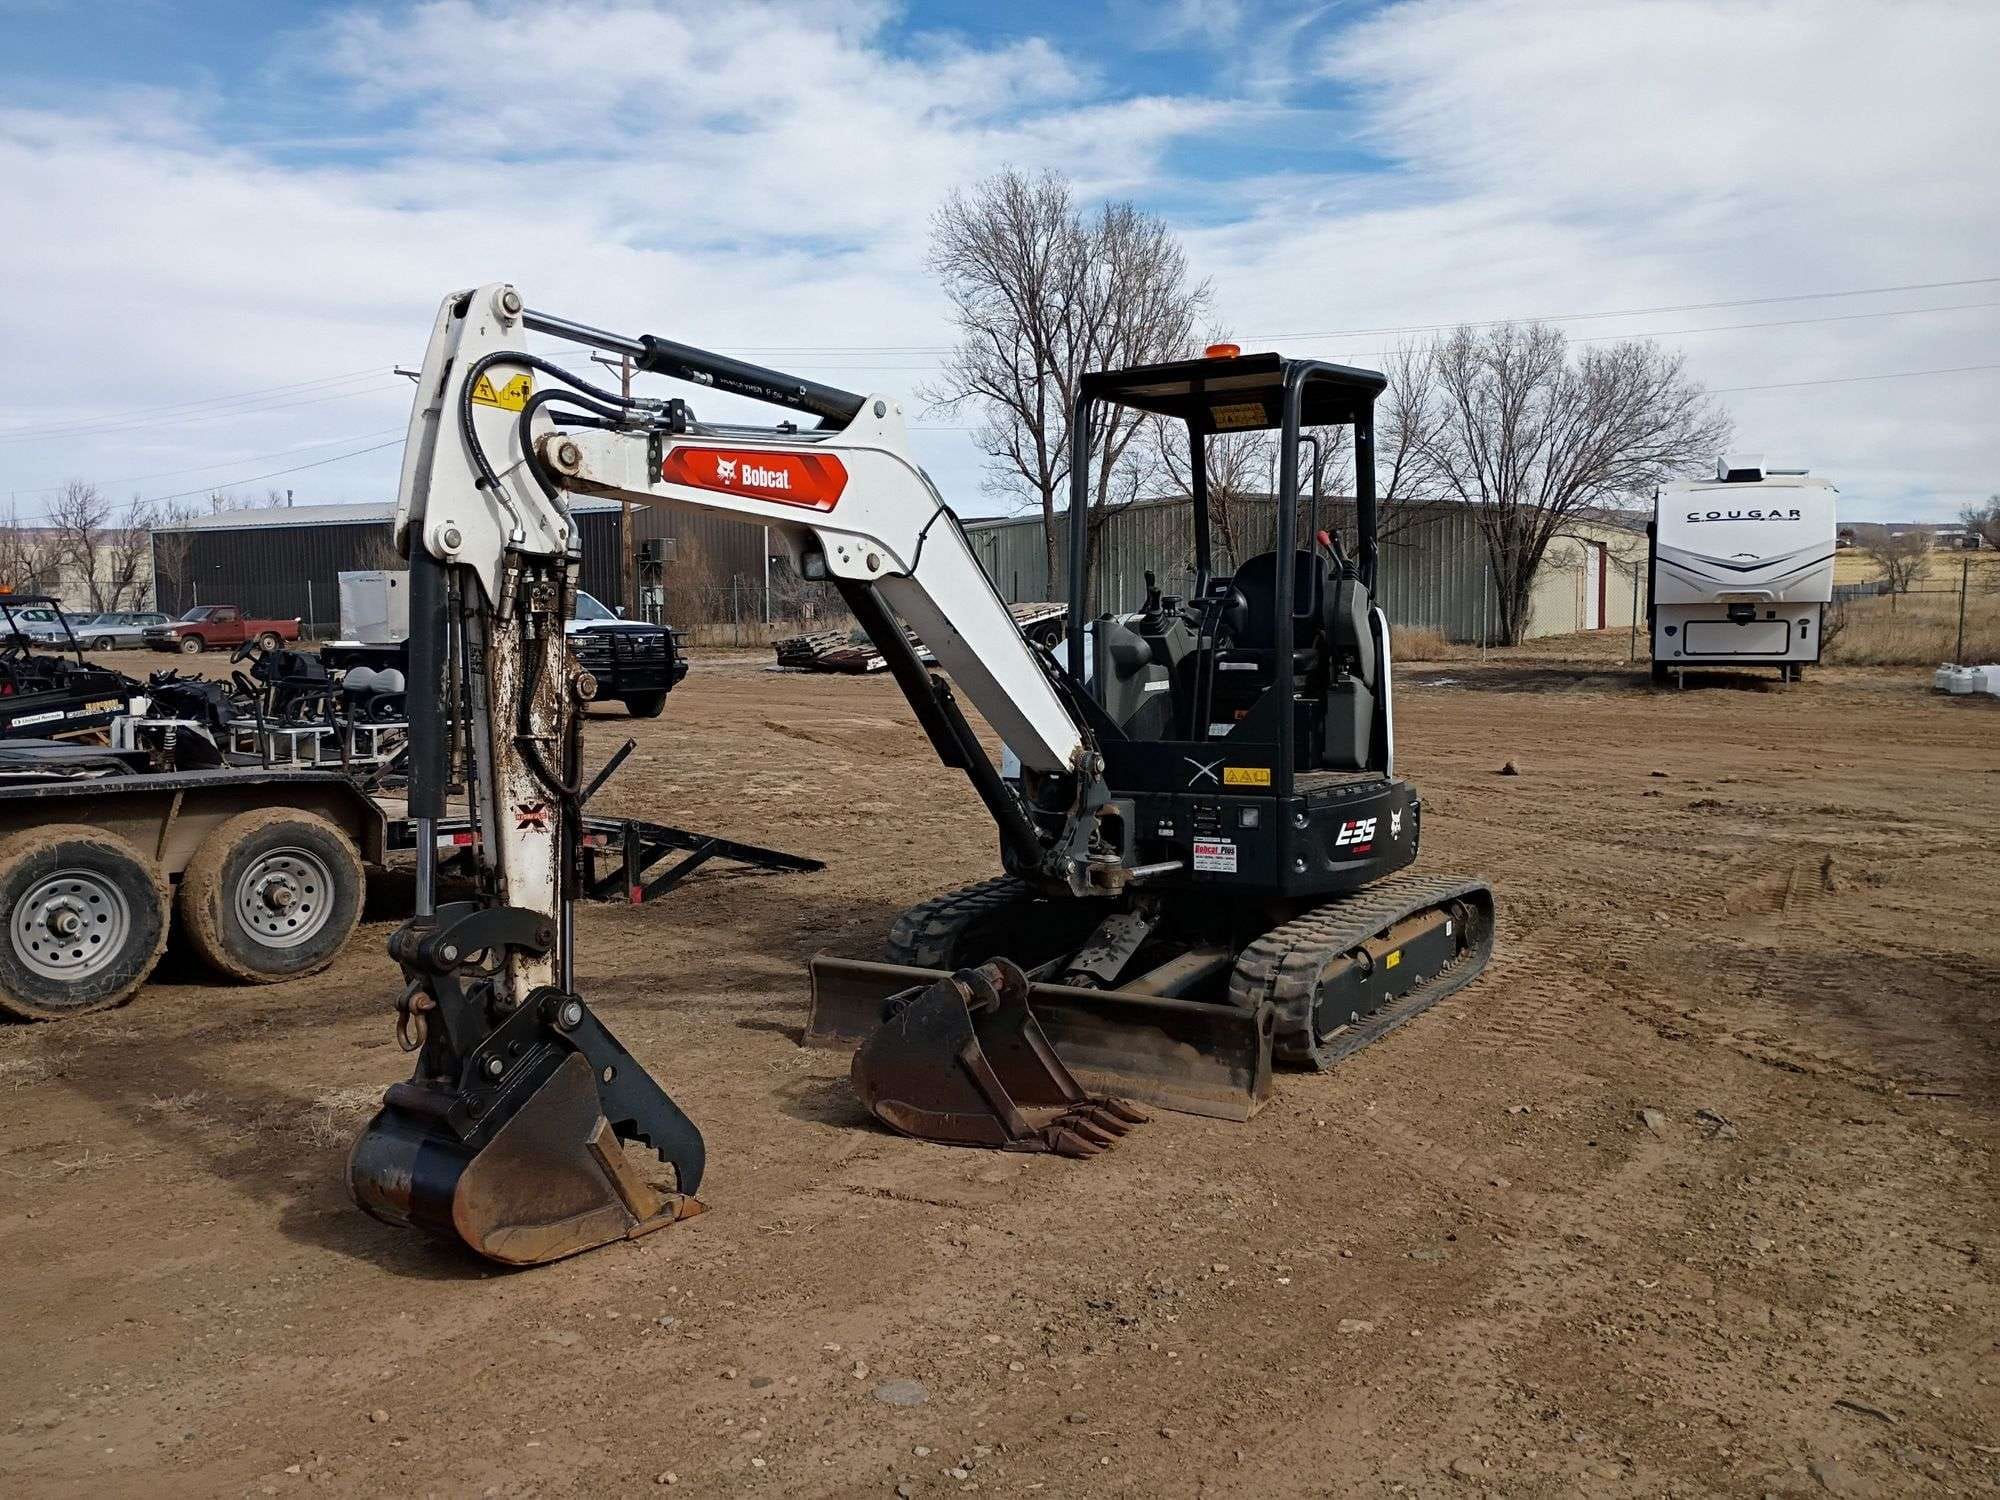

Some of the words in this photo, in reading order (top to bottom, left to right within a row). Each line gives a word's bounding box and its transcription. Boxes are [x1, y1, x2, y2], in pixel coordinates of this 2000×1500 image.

[742, 464, 789, 489] Bobcat
[1686, 509, 1800, 520] COUGAR
[1335, 817, 1377, 845] E35
[1195, 844, 1218, 855] Bobcat
[1221, 846, 1235, 855] Plus
